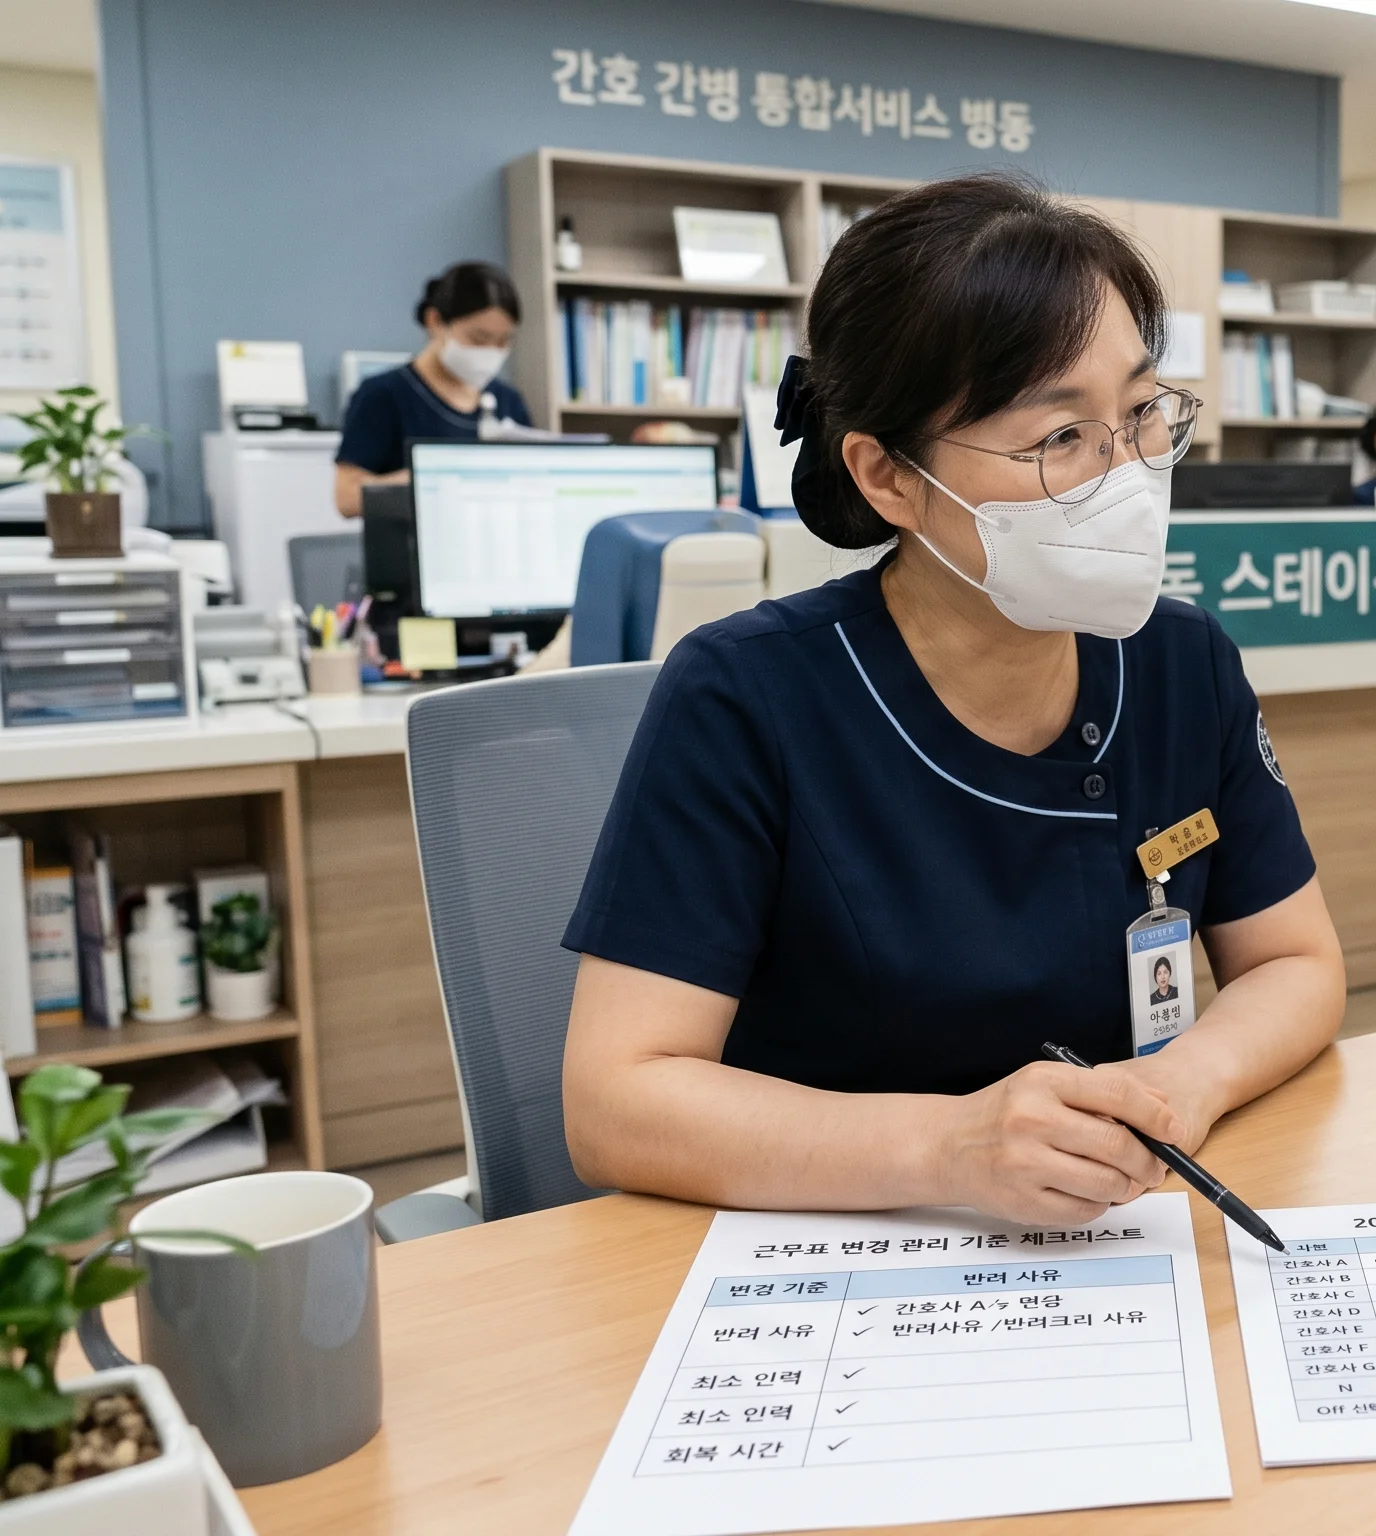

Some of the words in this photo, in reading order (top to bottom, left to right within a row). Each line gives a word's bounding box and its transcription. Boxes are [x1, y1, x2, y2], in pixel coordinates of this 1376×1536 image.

[552, 49, 645, 106] 간호
[655, 62, 738, 122] 간병
[752, 71, 952, 140] 통합서비스
[960, 96, 1035, 153] 병동
[753, 1243, 829, 1259] 근무표
[841, 1239, 890, 1255] 변경
[899, 1237, 949, 1253] 관리
[959, 1234, 1011, 1250] 기준
[1020, 1226, 1146, 1248] 체크리스트
[1283, 1259, 1331, 1269] 간호사
[1336, 1258, 1348, 1266] A
[963, 1271, 1007, 1286] 반려
[1016, 1269, 1062, 1283] 사유
[1286, 1274, 1335, 1286] 간호사
[1339, 1274, 1351, 1282] B
[729, 1283, 775, 1297] 변경
[782, 1281, 829, 1295] 기준
[1290, 1291, 1339, 1302] 간호사
[1344, 1290, 1355, 1298] C
[895, 1300, 962, 1316] 간호사
[1294, 1308, 1342, 1319] 간호사
[1348, 1308, 1361, 1316] D
[892, 1319, 983, 1337] 반려사유
[1103, 1310, 1147, 1325] 사유
[1298, 1325, 1348, 1337] 간호사
[1353, 1325, 1365, 1334] E
[713, 1326, 760, 1342] 반려
[768, 1324, 815, 1339] 사유
[1301, 1343, 1353, 1356] 간호사
[1358, 1343, 1369, 1353] F
[1305, 1362, 1358, 1375] 간호사
[1362, 1362, 1376, 1371] G
[691, 1375, 743, 1391] 최소
[754, 1370, 802, 1387] 인력
[1338, 1383, 1353, 1393] N
[678, 1409, 731, 1427] 최소
[743, 1404, 793, 1423] 인력
[1316, 1405, 1344, 1415] Off
[664, 1445, 720, 1464] 회복
[730, 1441, 782, 1459] 시간
